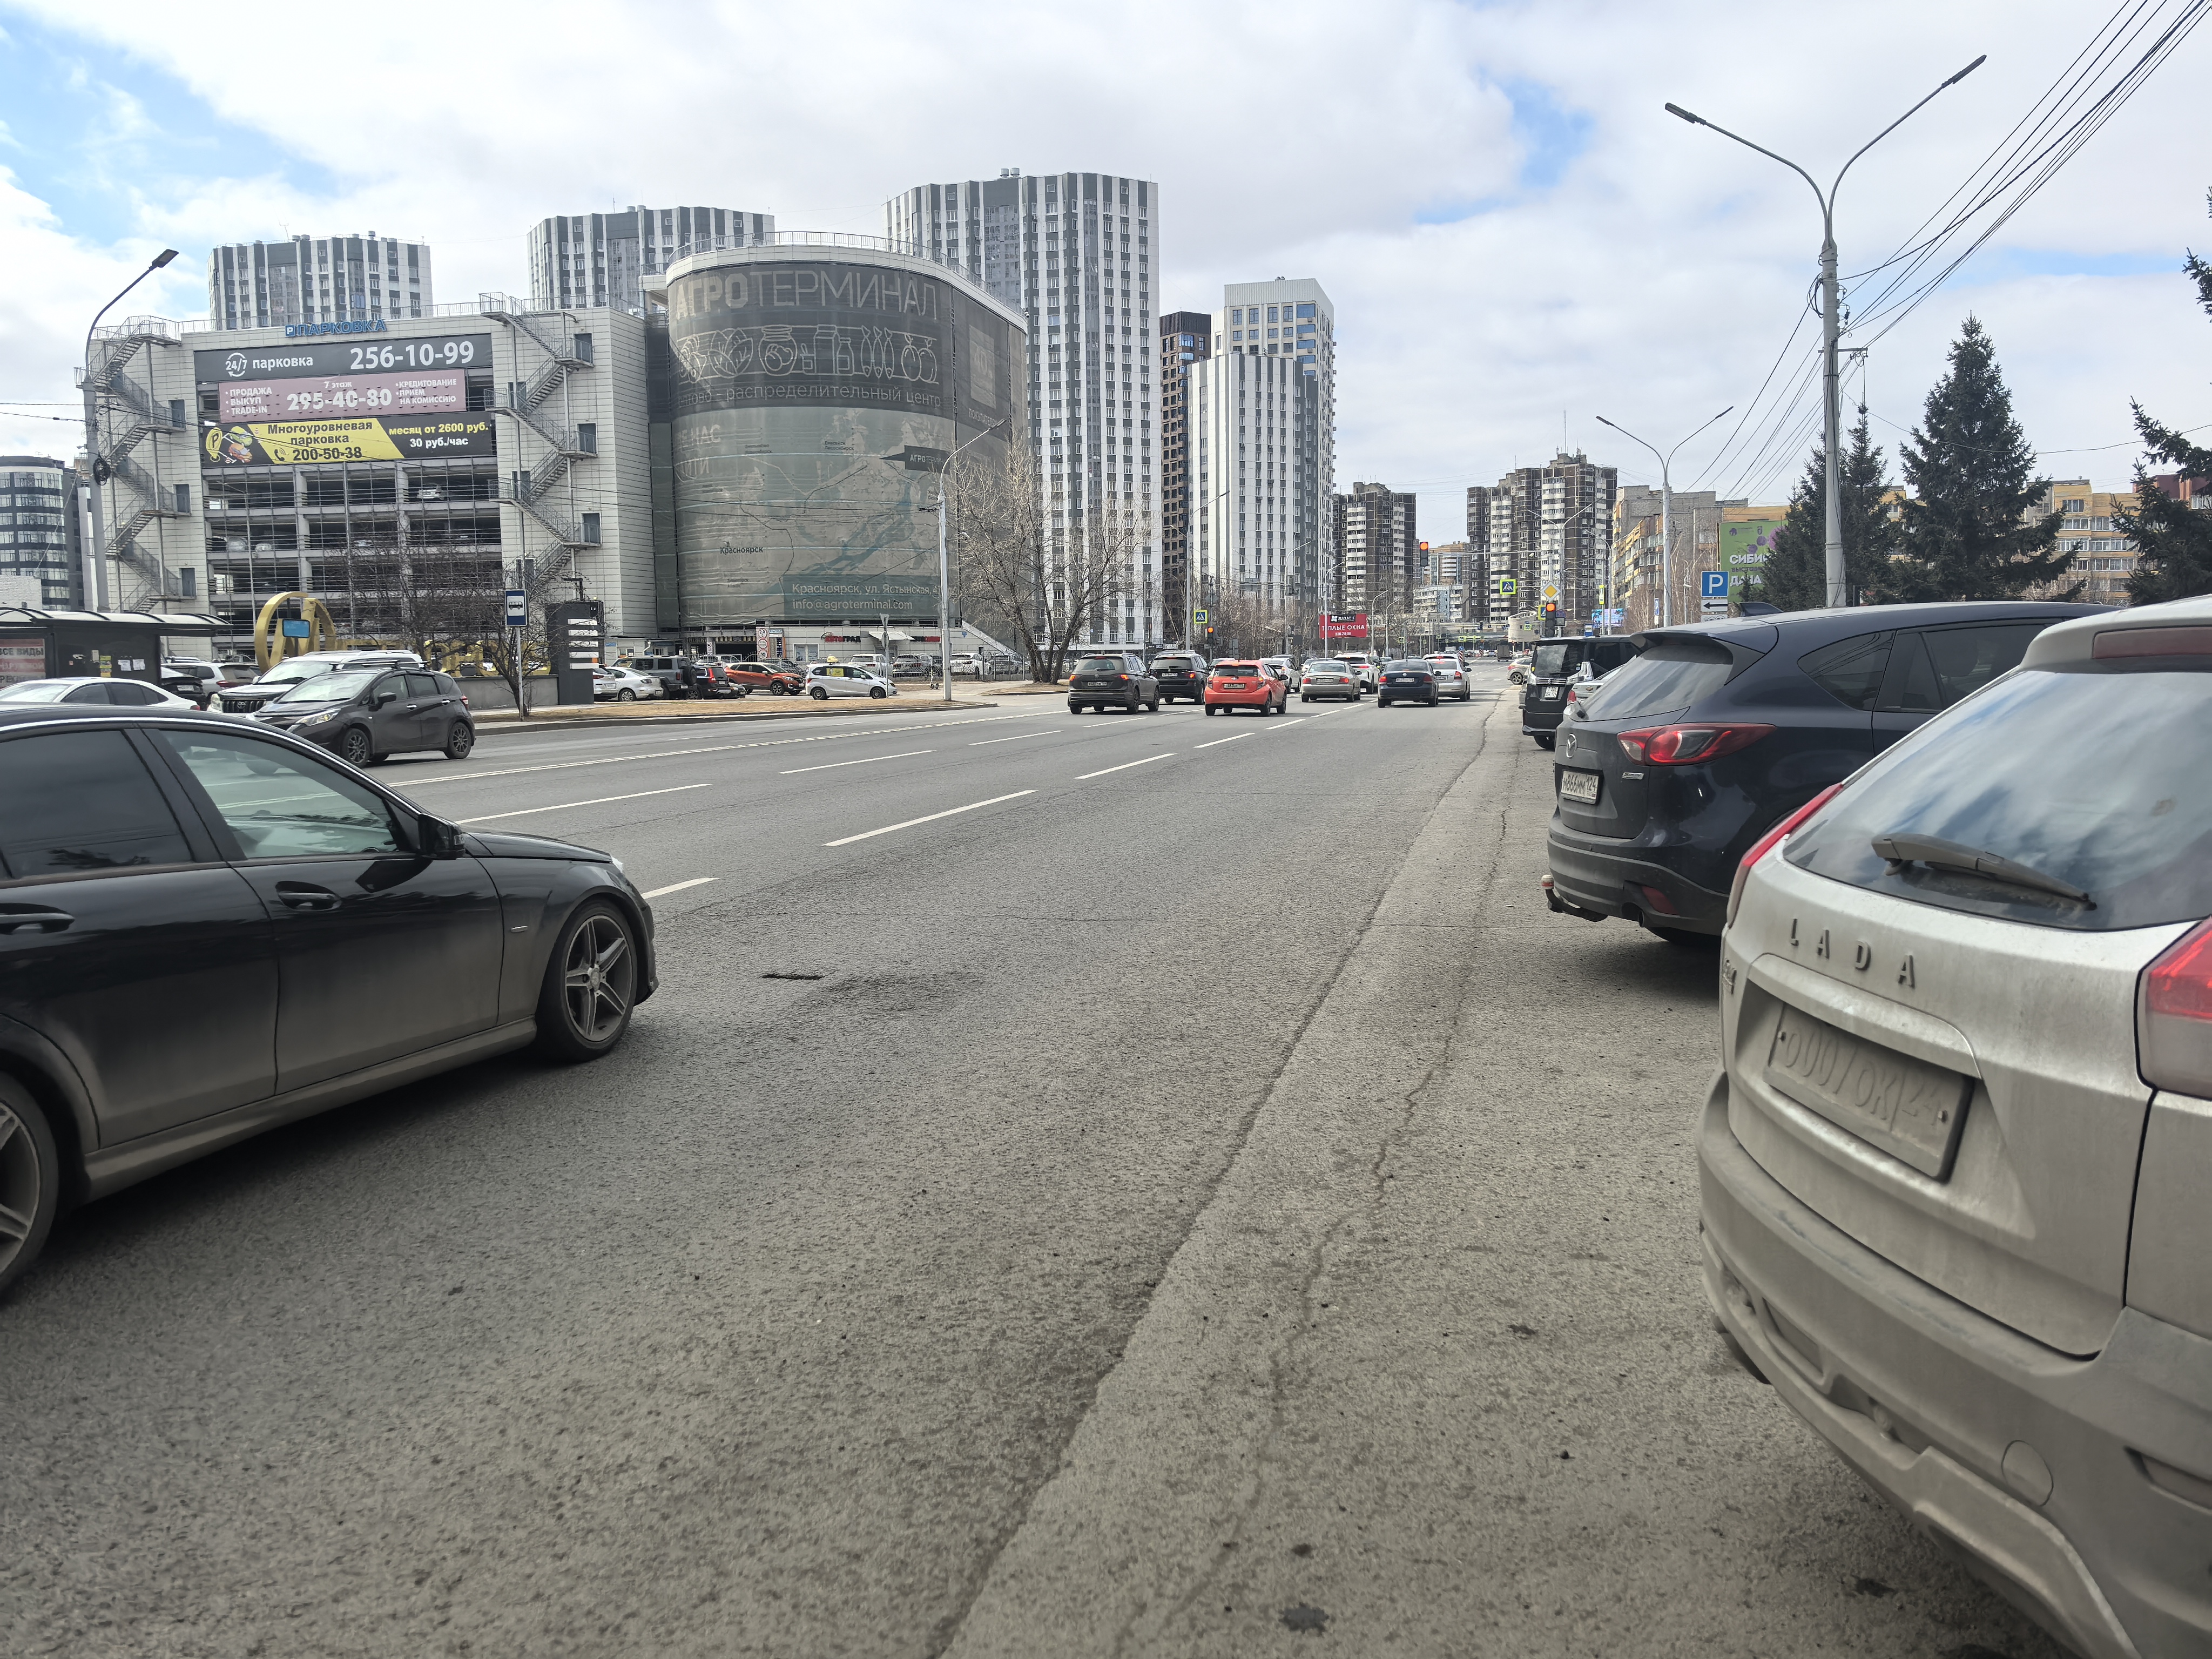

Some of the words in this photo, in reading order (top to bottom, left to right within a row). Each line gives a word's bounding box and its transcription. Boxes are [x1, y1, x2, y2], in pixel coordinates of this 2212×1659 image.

[675, 271, 937, 320] АГРОТЕРМИНАЛ
[296, 319, 387, 336] ПАРКОВКА
[350, 341, 474, 370] 256-10-99
[225, 358, 247, 372] 24/7
[252, 357, 314, 371] парковка
[399, 379, 457, 388] КРЕДИТОВАНИЕ
[230, 387, 273, 397] ПРОДАЖА
[726, 385, 901, 403] распределительный
[906, 391, 941, 408] центр
[231, 397, 262, 406] ВЫКУП
[287, 388, 392, 411] 295-40-80
[412, 396, 456, 404] КОМИССИЮ
[231, 406, 268, 415] TRADE-IN
[268, 422, 373, 435] Многоуровневая
[389, 427, 422, 436] месяц
[438, 423, 464, 433] 2600
[467, 422, 489, 434] руб.
[291, 435, 349, 446] парковка
[409, 438, 422, 448] 30
[426, 437, 469, 449] руб./час
[293, 447, 362, 461] 200-50-38
[720, 547, 764, 555] Красноярск
[792, 583, 862, 595] Красноярск,
[865, 585, 880, 594] ул.
[1709, 574, 1723, 594] P
[792, 599, 913, 611] info@agroterminal.com
[0, 648, 14, 656] СЕ
[1789, 918, 1916, 989] LADA
